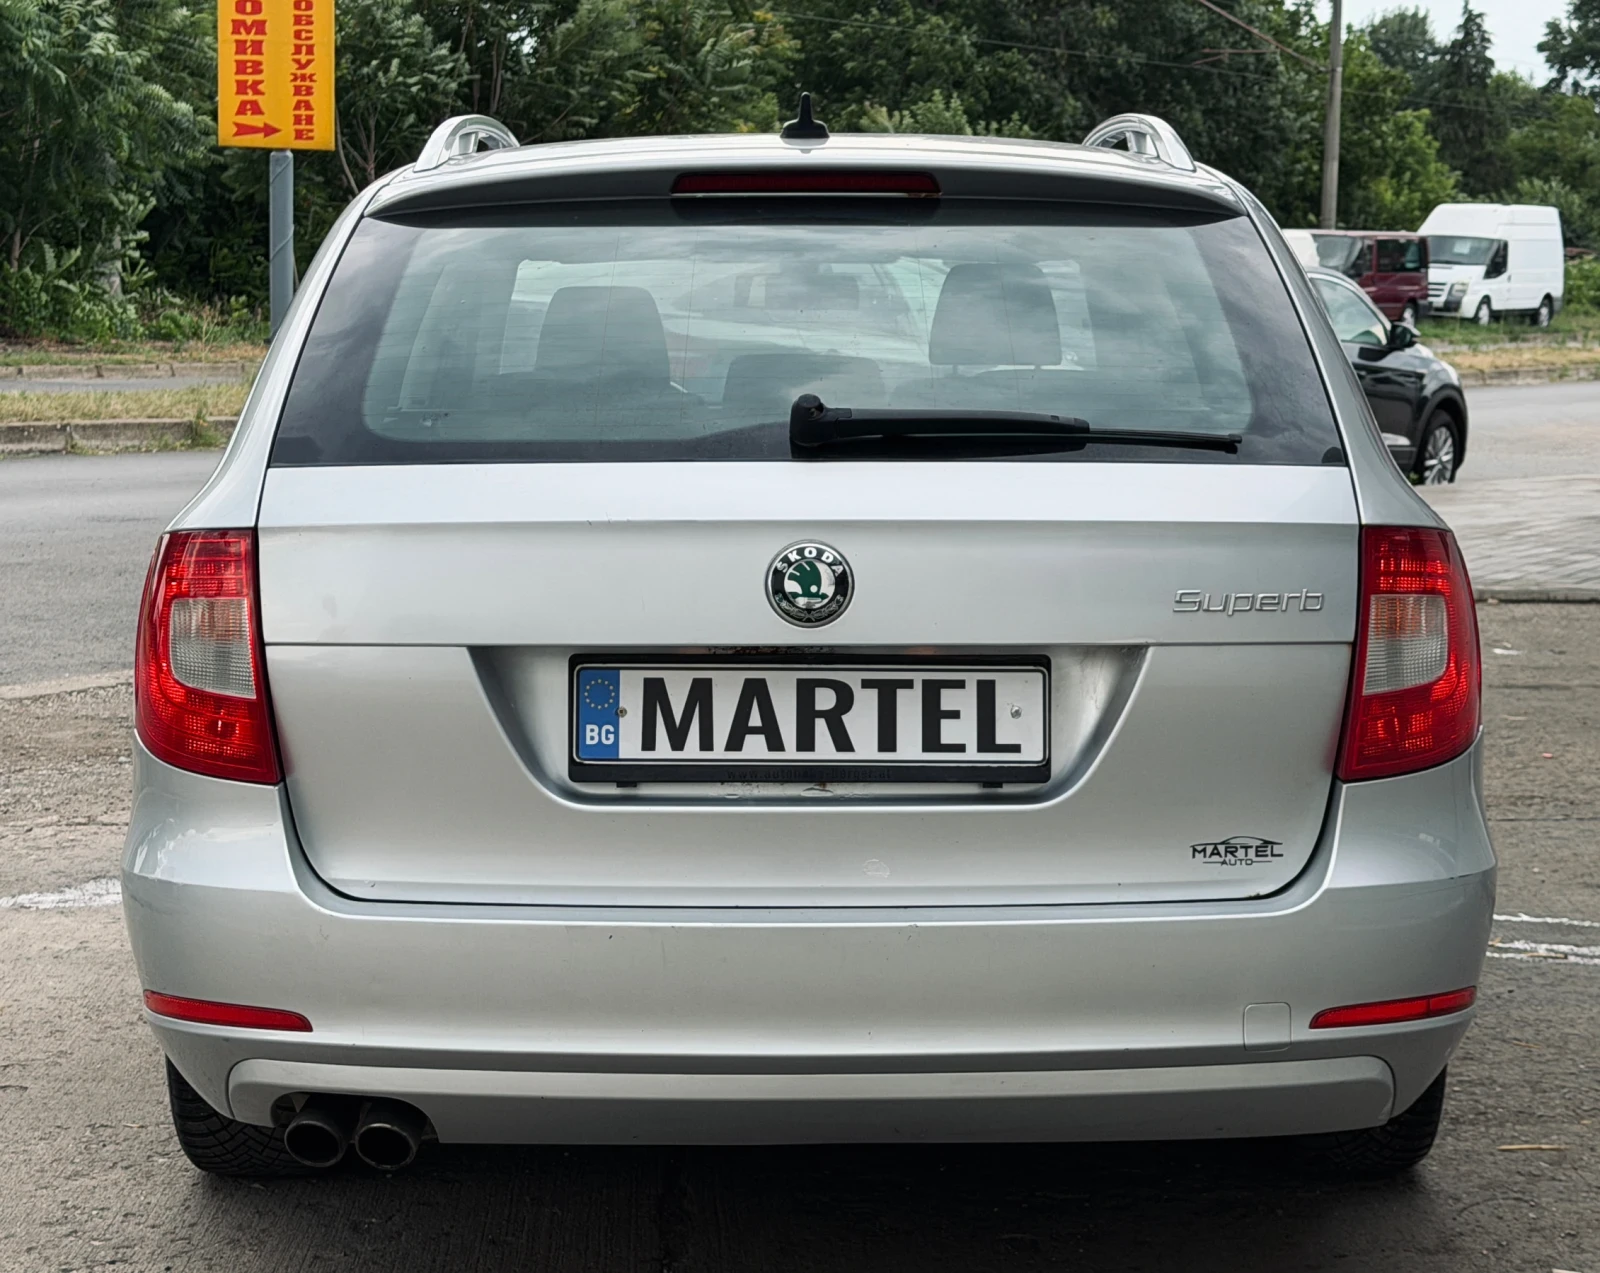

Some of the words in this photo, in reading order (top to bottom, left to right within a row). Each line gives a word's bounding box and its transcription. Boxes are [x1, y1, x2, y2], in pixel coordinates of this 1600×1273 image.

[290, 0, 317, 141] ОБСЛУЖВАНЕ
[1173, 588, 1323, 616] Superb
[640, 677, 1022, 754] MARTEL
[585, 724, 615, 745] BG
[1192, 845, 1284, 859] MARTEL
[1221, 858, 1253, 866] AUTO
